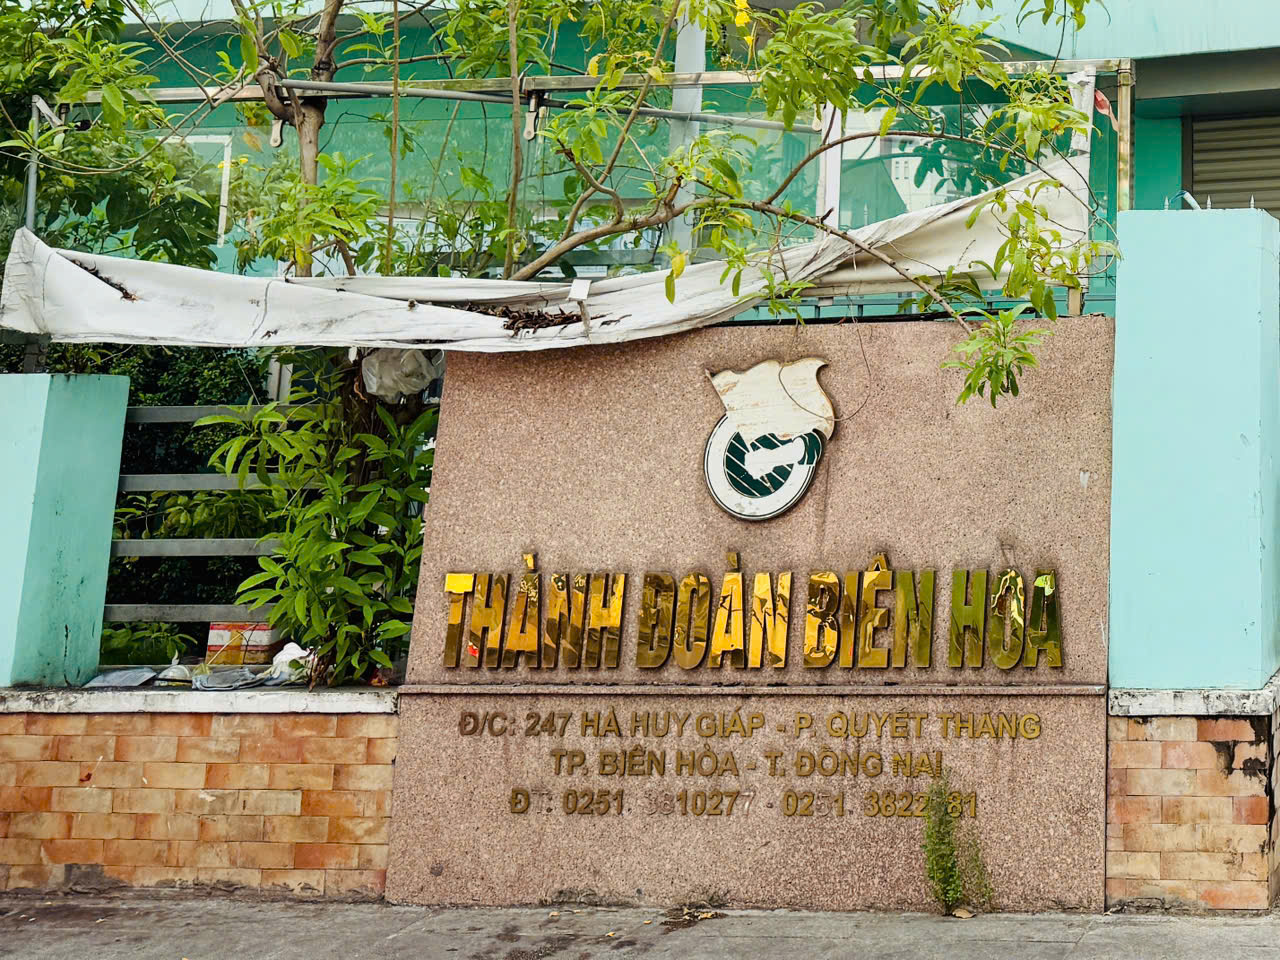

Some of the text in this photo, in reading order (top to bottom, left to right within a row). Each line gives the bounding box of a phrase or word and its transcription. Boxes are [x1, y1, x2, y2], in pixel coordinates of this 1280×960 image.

[443, 551, 628, 669] THÀNH
[635, 551, 795, 670] ĐOÀN
[803, 551, 936, 669] BIÊN
[524, 710, 573, 737] 247
[629, 710, 691, 738] HUY
[695, 706, 766, 738] GIÁP
[794, 711, 817, 738] P.
[550, 748, 590, 776] TP.
[599, 743, 667, 776] BIÊN
[764, 750, 786, 777] T.
[892, 750, 943, 778] NAI
[862, 790, 978, 819] 382281
